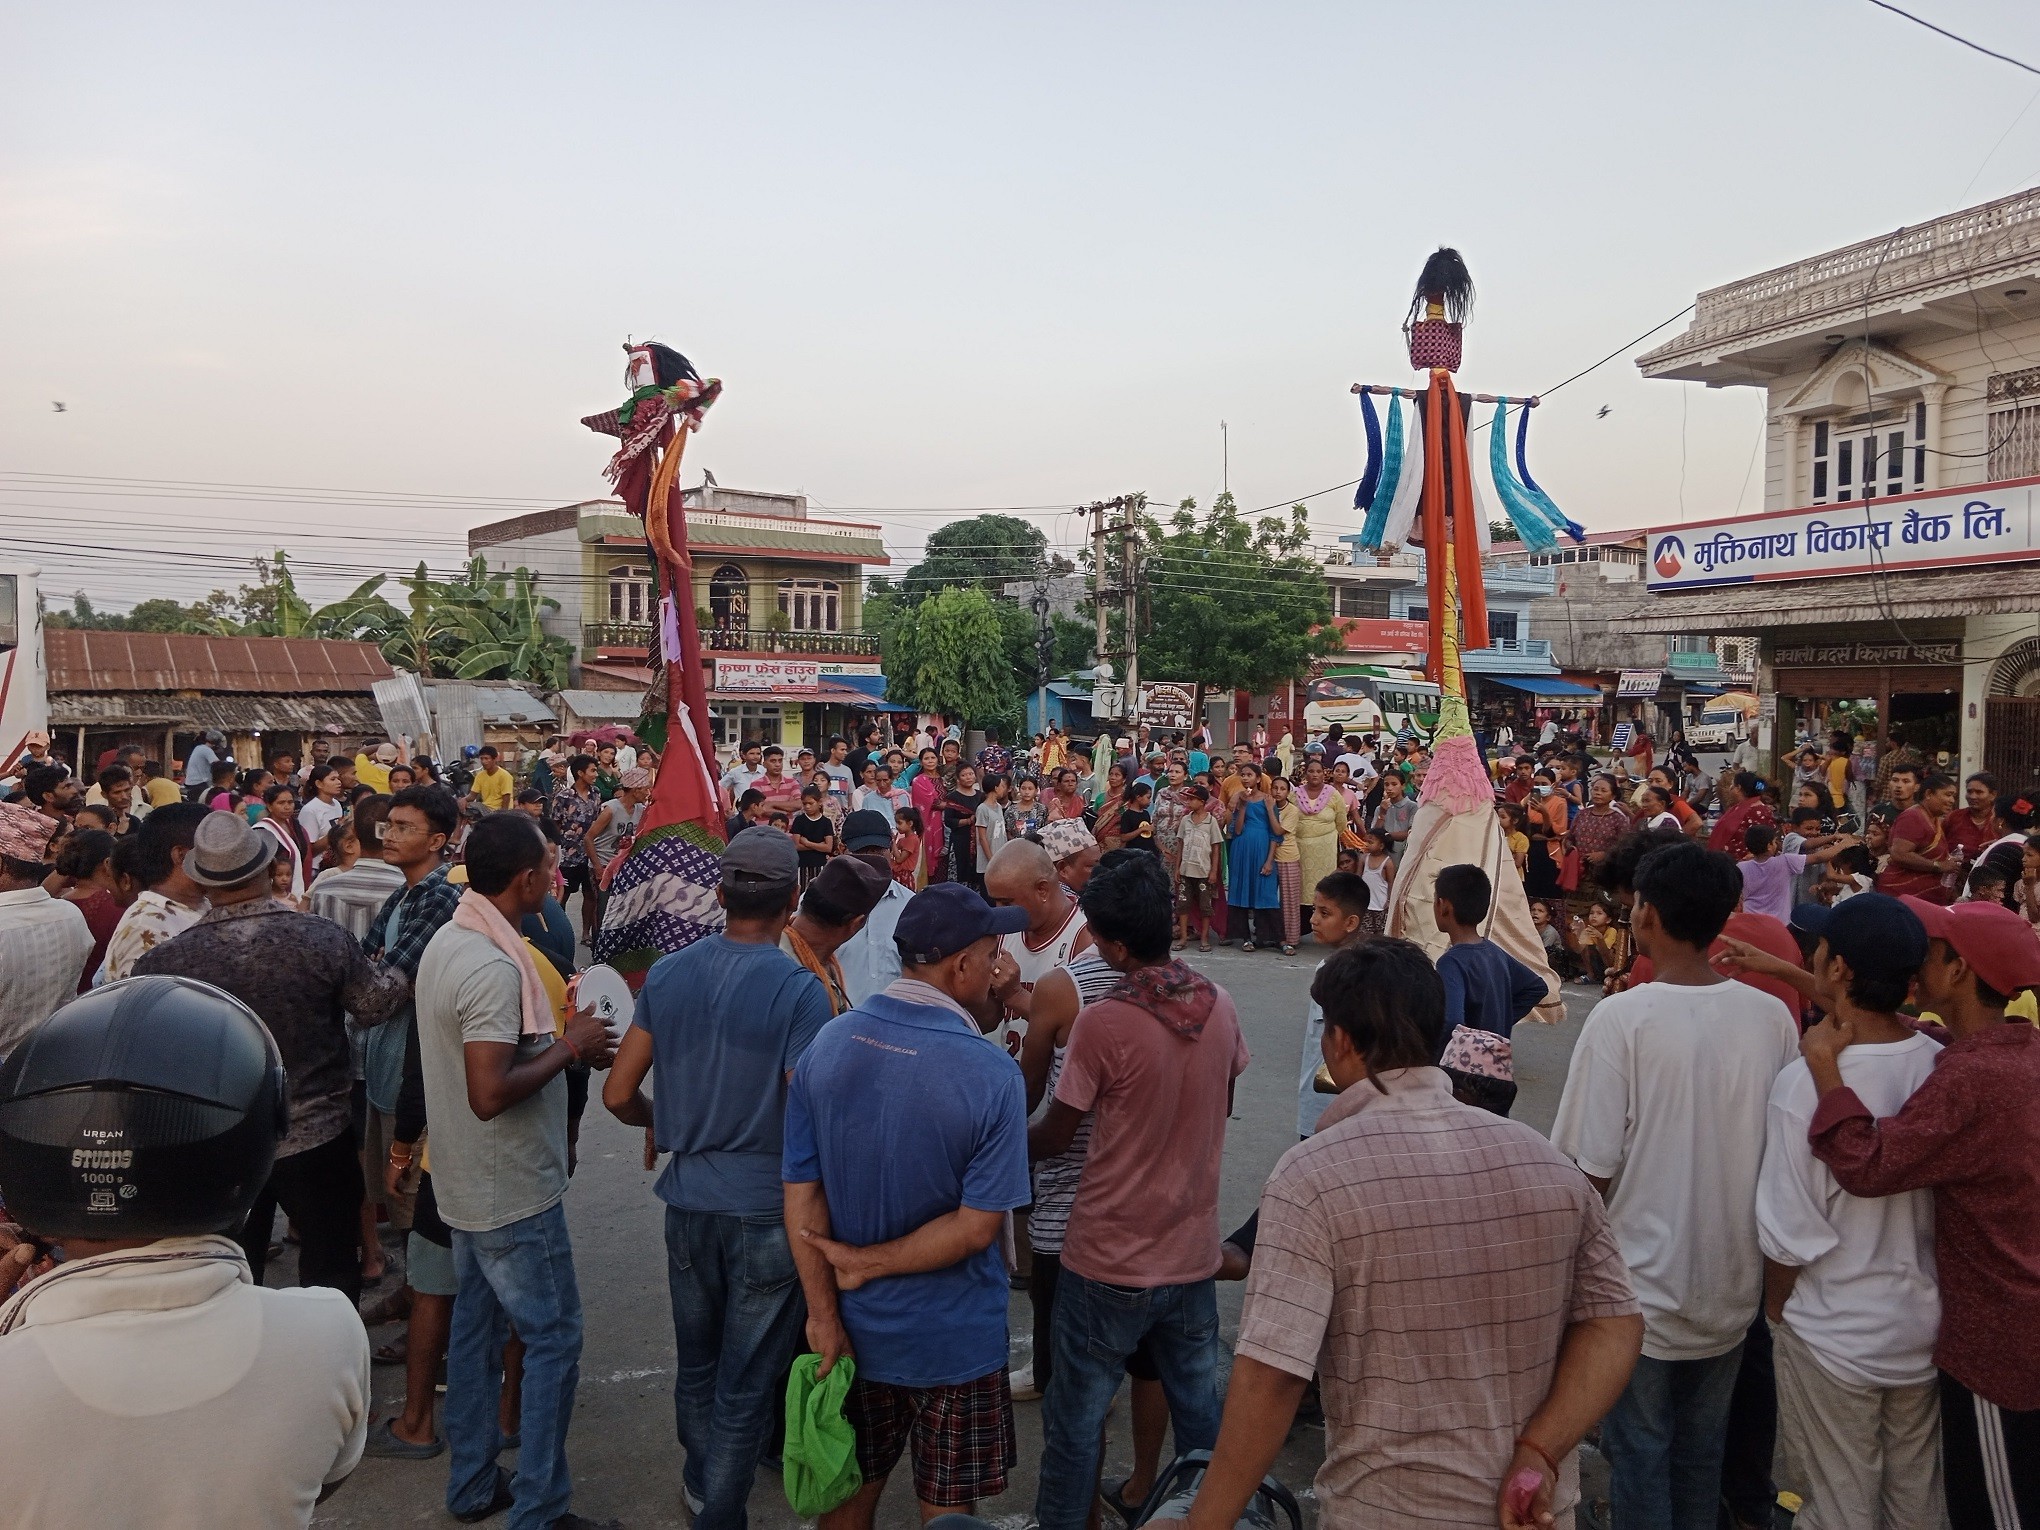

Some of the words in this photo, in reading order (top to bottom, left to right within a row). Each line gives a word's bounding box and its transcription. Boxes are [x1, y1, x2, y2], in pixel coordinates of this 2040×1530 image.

[1694, 532, 1798, 572] मुक्तिनाथ
[1806, 520, 1893, 556] विकास
[1901, 508, 1953, 545] बैंक
[1964, 501, 2012, 540] लि.
[1854, 642, 1907, 664] किराना
[719, 663, 751, 674] कृष्ण
[785, 665, 816, 675] हाउस
[83, 1129, 123, 1138] URBAN
[71, 1148, 133, 1169] STUDDS
[81, 1172, 114, 1183] 1000
